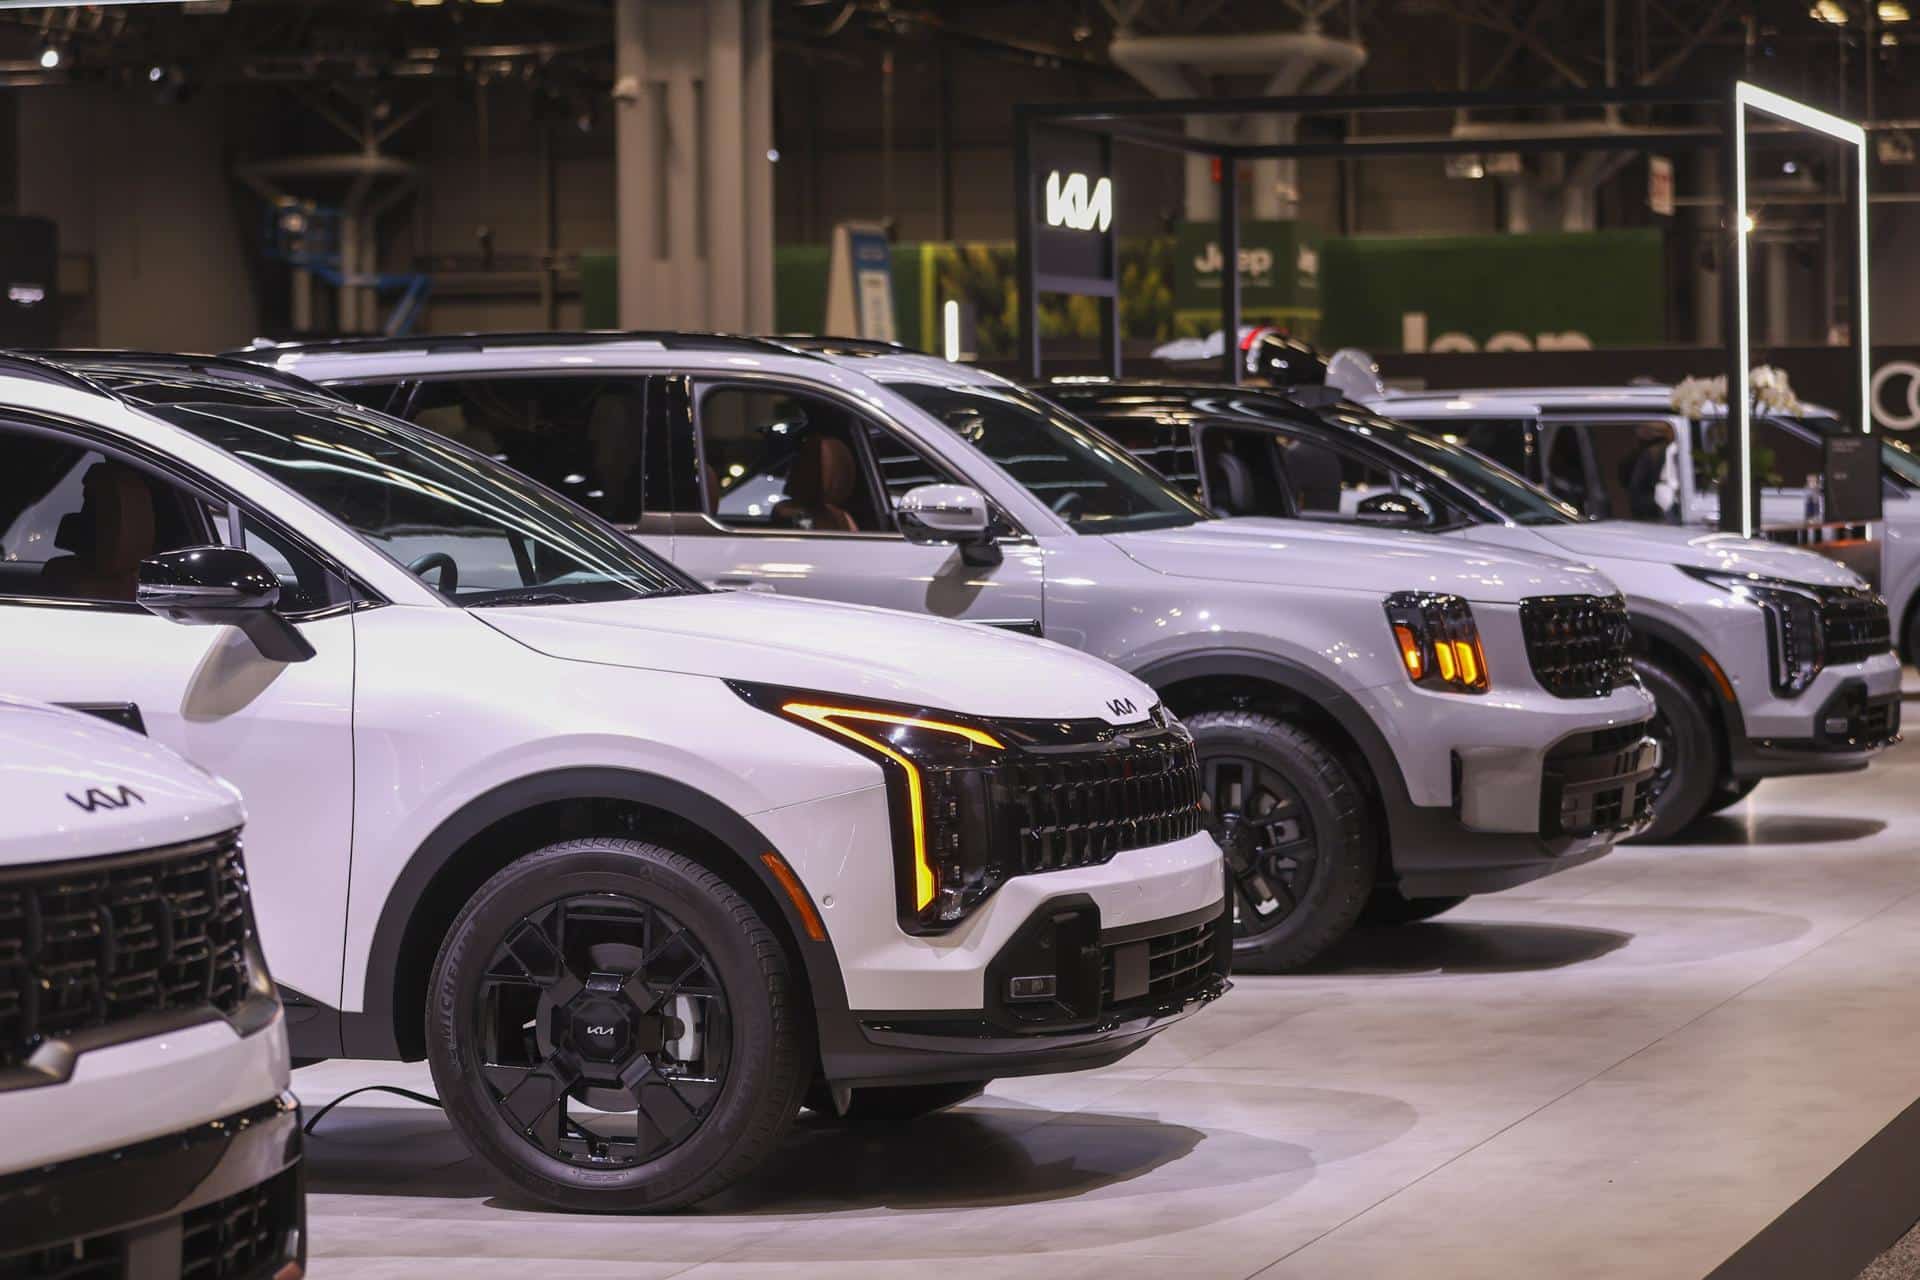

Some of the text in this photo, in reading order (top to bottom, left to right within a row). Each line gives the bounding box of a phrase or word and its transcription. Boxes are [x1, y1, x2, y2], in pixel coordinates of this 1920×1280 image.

[1046, 169, 1112, 233] KIA
[1105, 697, 1138, 717] KIA
[65, 784, 146, 812] KIA
[586, 1026, 614, 1035] KIA
